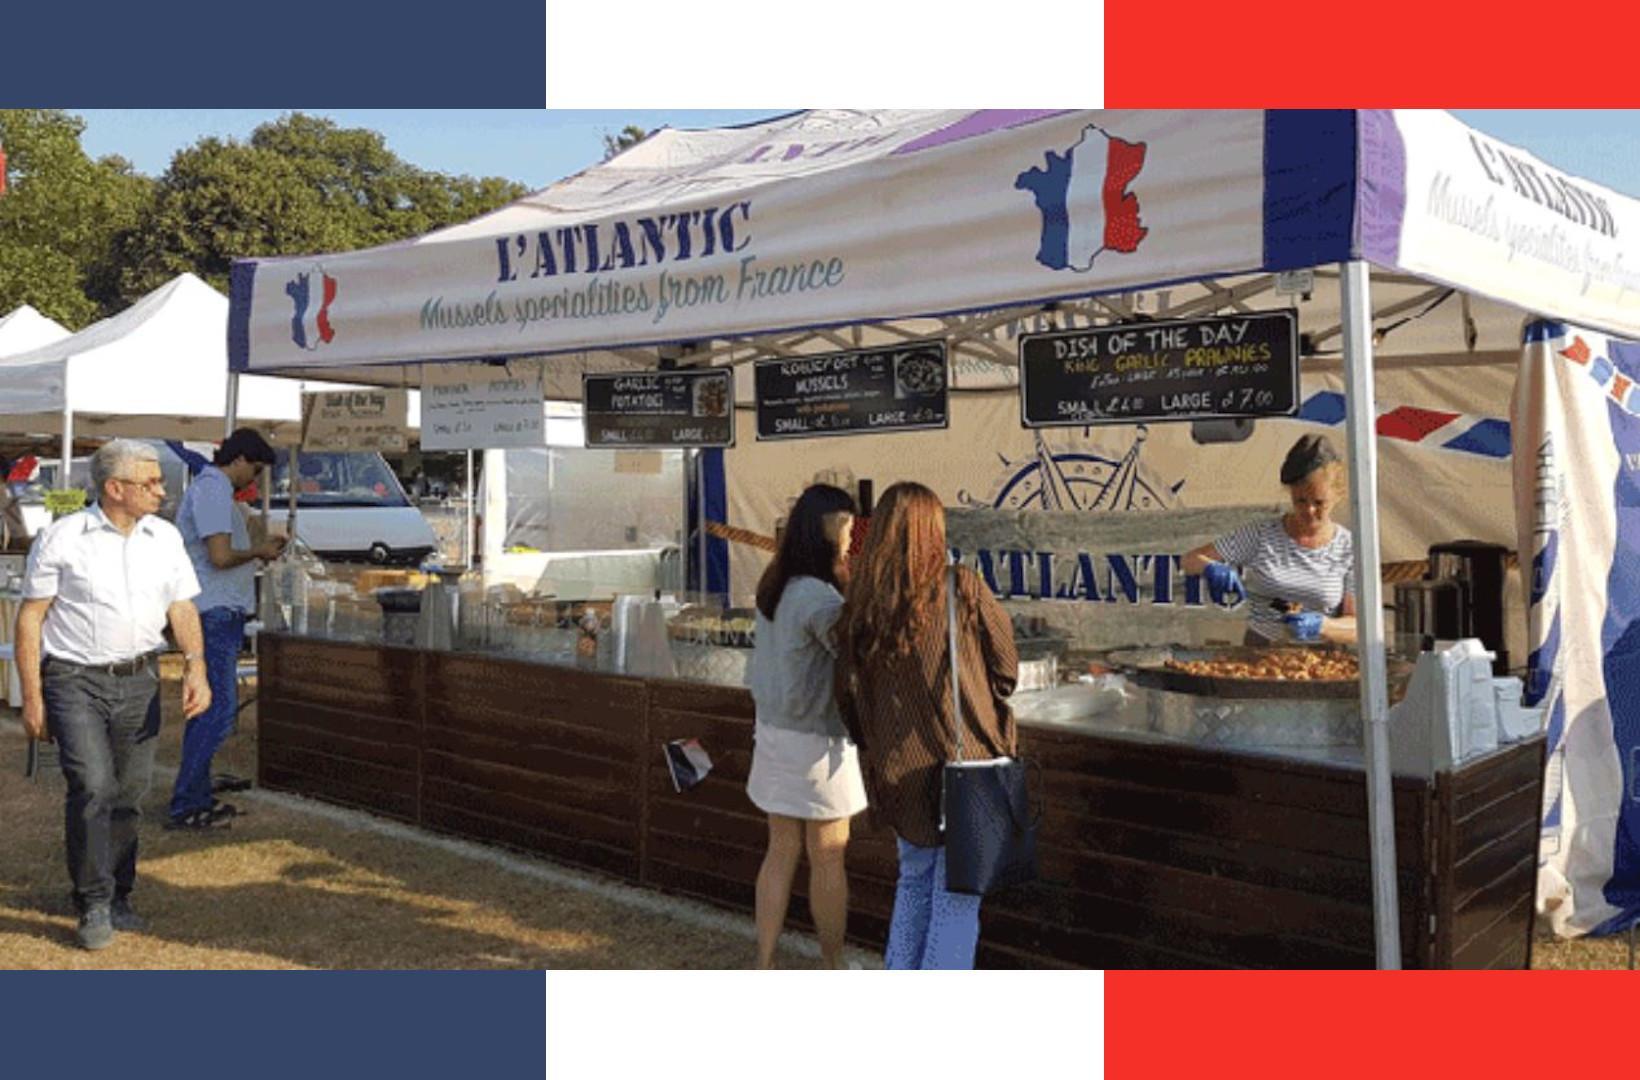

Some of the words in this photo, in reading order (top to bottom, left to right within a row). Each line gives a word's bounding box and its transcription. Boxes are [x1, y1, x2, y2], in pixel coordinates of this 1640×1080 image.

[496, 201, 751, 282] L'ATLANTIC
[419, 290, 508, 330] Mussels
[513, 278, 650, 332] specialities
[652, 269, 729, 324] from
[736, 255, 845, 298] France
[1054, 338, 1098, 359] DISH
[1108, 333, 1137, 354] OF
[1145, 326, 1189, 350] THE
[1201, 321, 1249, 346] DAY
[1161, 392, 1211, 410] LARGE
